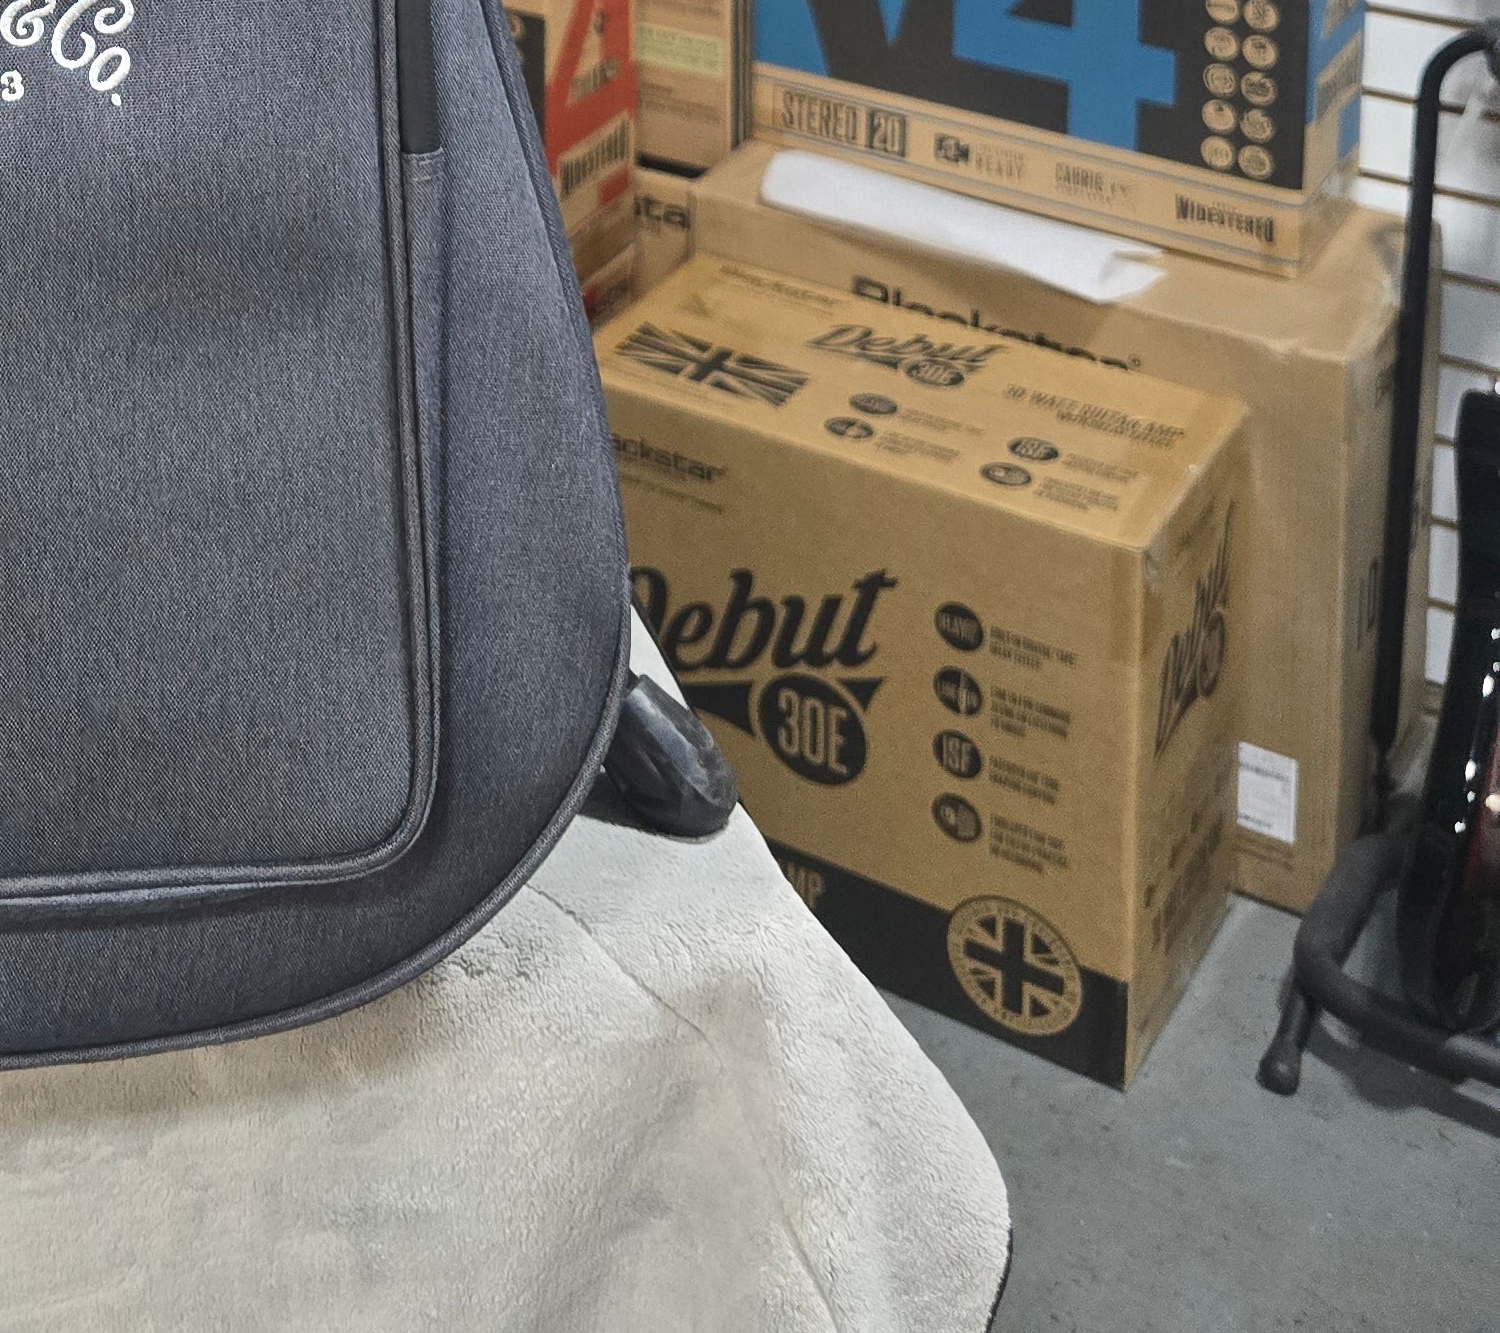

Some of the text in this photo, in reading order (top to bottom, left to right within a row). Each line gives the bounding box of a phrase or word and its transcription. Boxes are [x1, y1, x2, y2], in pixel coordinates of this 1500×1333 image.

[782, 91, 858, 145] STEREO
[804, 323, 1011, 364] Debut
[776, 686, 848, 775] 30E
